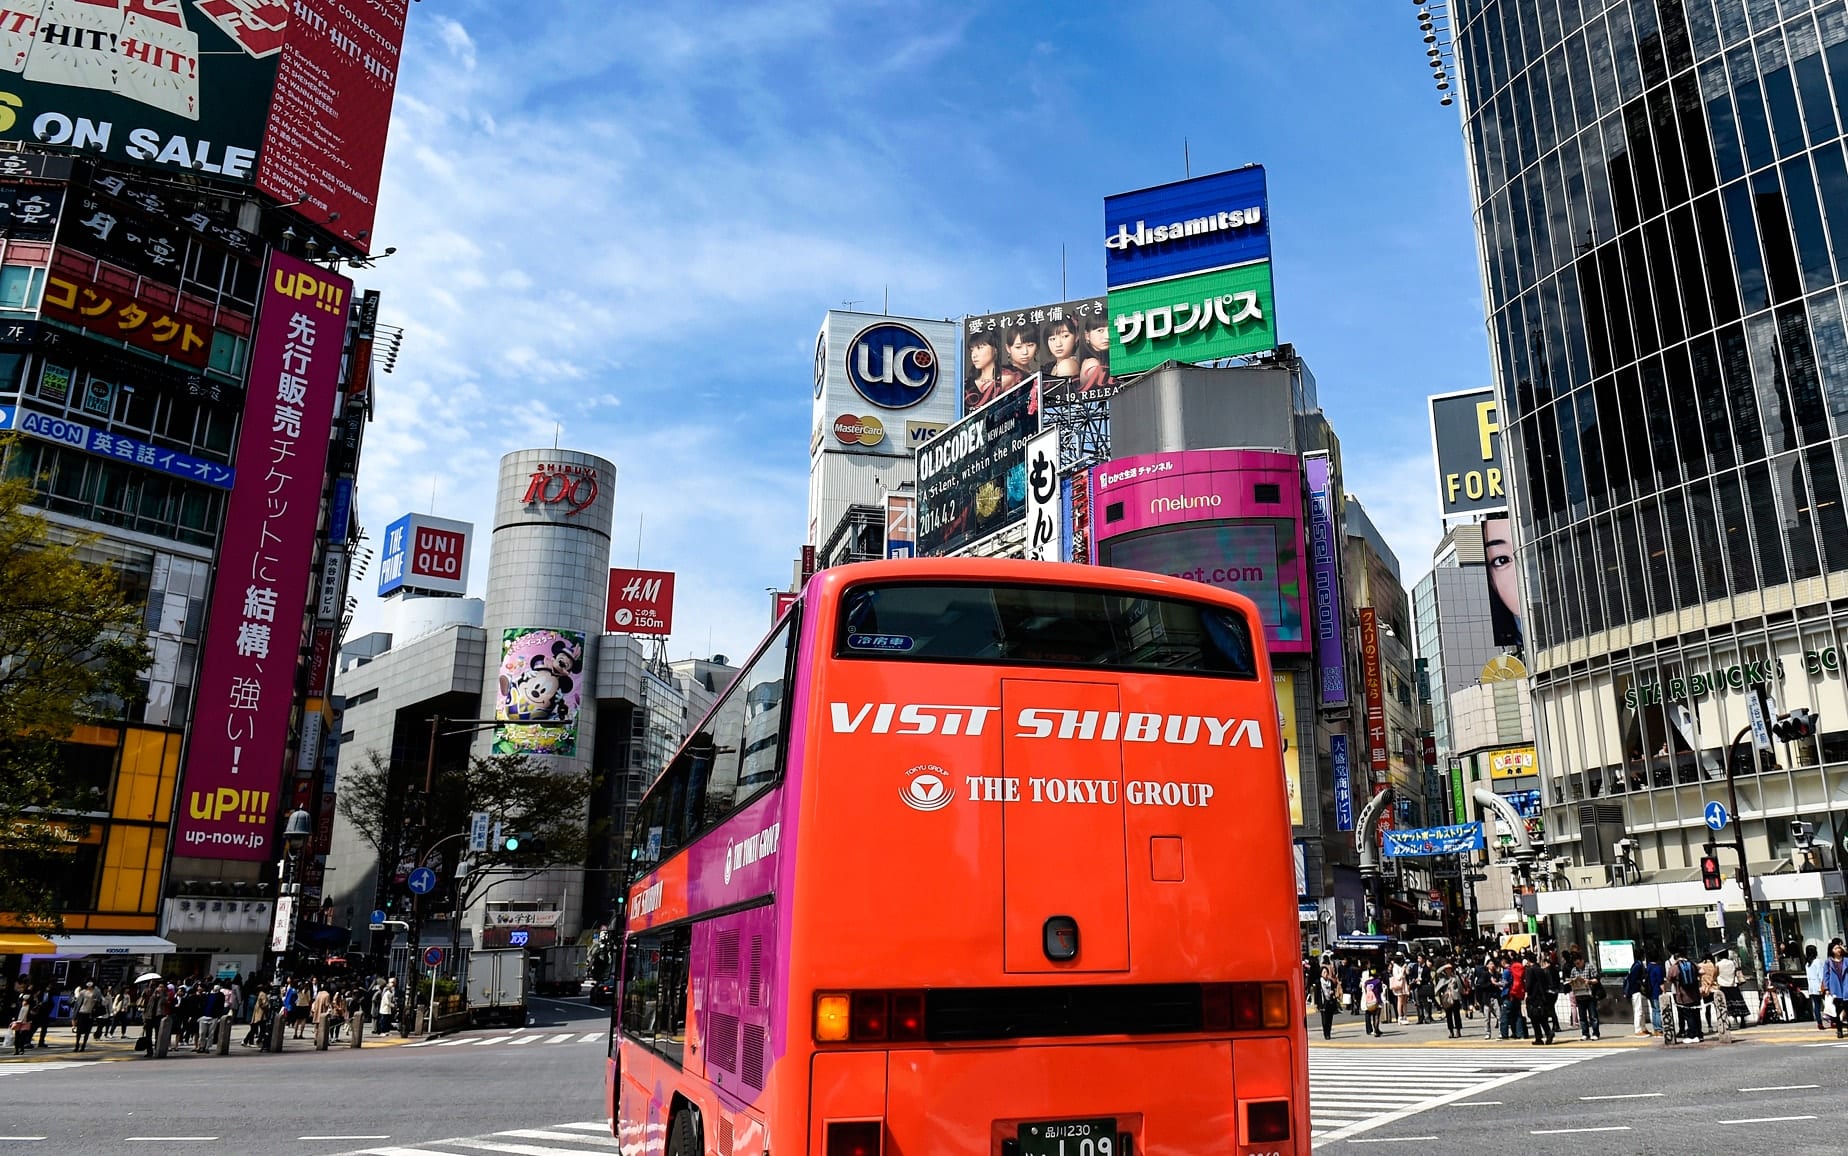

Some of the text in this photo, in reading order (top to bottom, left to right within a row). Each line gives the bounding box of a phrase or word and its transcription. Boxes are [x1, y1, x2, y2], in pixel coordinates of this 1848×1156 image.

[0, 9, 40, 37] IT!
[40, 23, 117, 53] HIT!
[338, 4, 398, 56] COLLECTION
[121, 37, 197, 79] HIT!
[293, 1, 328, 36] HIT!
[329, 27, 361, 62] HIT!
[363, 53, 394, 87] HIT!
[33, 112, 112, 152] ON
[125, 129, 256, 178] SALE
[83, 199, 99, 210] 9F
[1105, 206, 1261, 249] Hisamitsu
[7, 326, 24, 337] 7F
[45, 277, 204, 351] コンタクト
[1114, 290, 1262, 344] サロンパス
[835, 424, 882, 435] MasterCard
[987, 418, 1015, 442] NEW ALBUM
[23, 413, 230, 482] AEON 英会話イーオン
[920, 420, 984, 481] OLDCODEX
[537, 463, 597, 478] SHIBUYA
[929, 476, 959, 498] Silent,
[962, 457, 990, 481] within
[993, 448, 1008, 463] the
[1109, 461, 1173, 485] わかさ生活 チャンネル
[520, 472, 598, 517] 109
[920, 500, 955, 538] 2014.4.2
[389, 526, 404, 553] THE
[421, 533, 456, 554] UNI
[380, 552, 404, 587] PRIME
[418, 552, 456, 574] QLO
[321, 556, 337, 615] 渋谷駅前ビル
[621, 577, 662, 604] H&M
[634, 617, 664, 628] 150m
[635, 609, 657, 618] この先
[1362, 612, 1388, 763] クスリのことなら 三千里
[1626, 658, 1785, 710] STARBUCKS
[830, 703, 1265, 749] VISIT SHIBUYA
[905, 764, 950, 777] TOKYU GROUP
[1334, 739, 1351, 825] 大盛堂商事ビル
[966, 776, 1215, 808] THE TOKYU GROUP
[185, 830, 264, 848] up-now.jp
[759, 823, 780, 860] GROUP
[510, 936, 528, 946] 109
